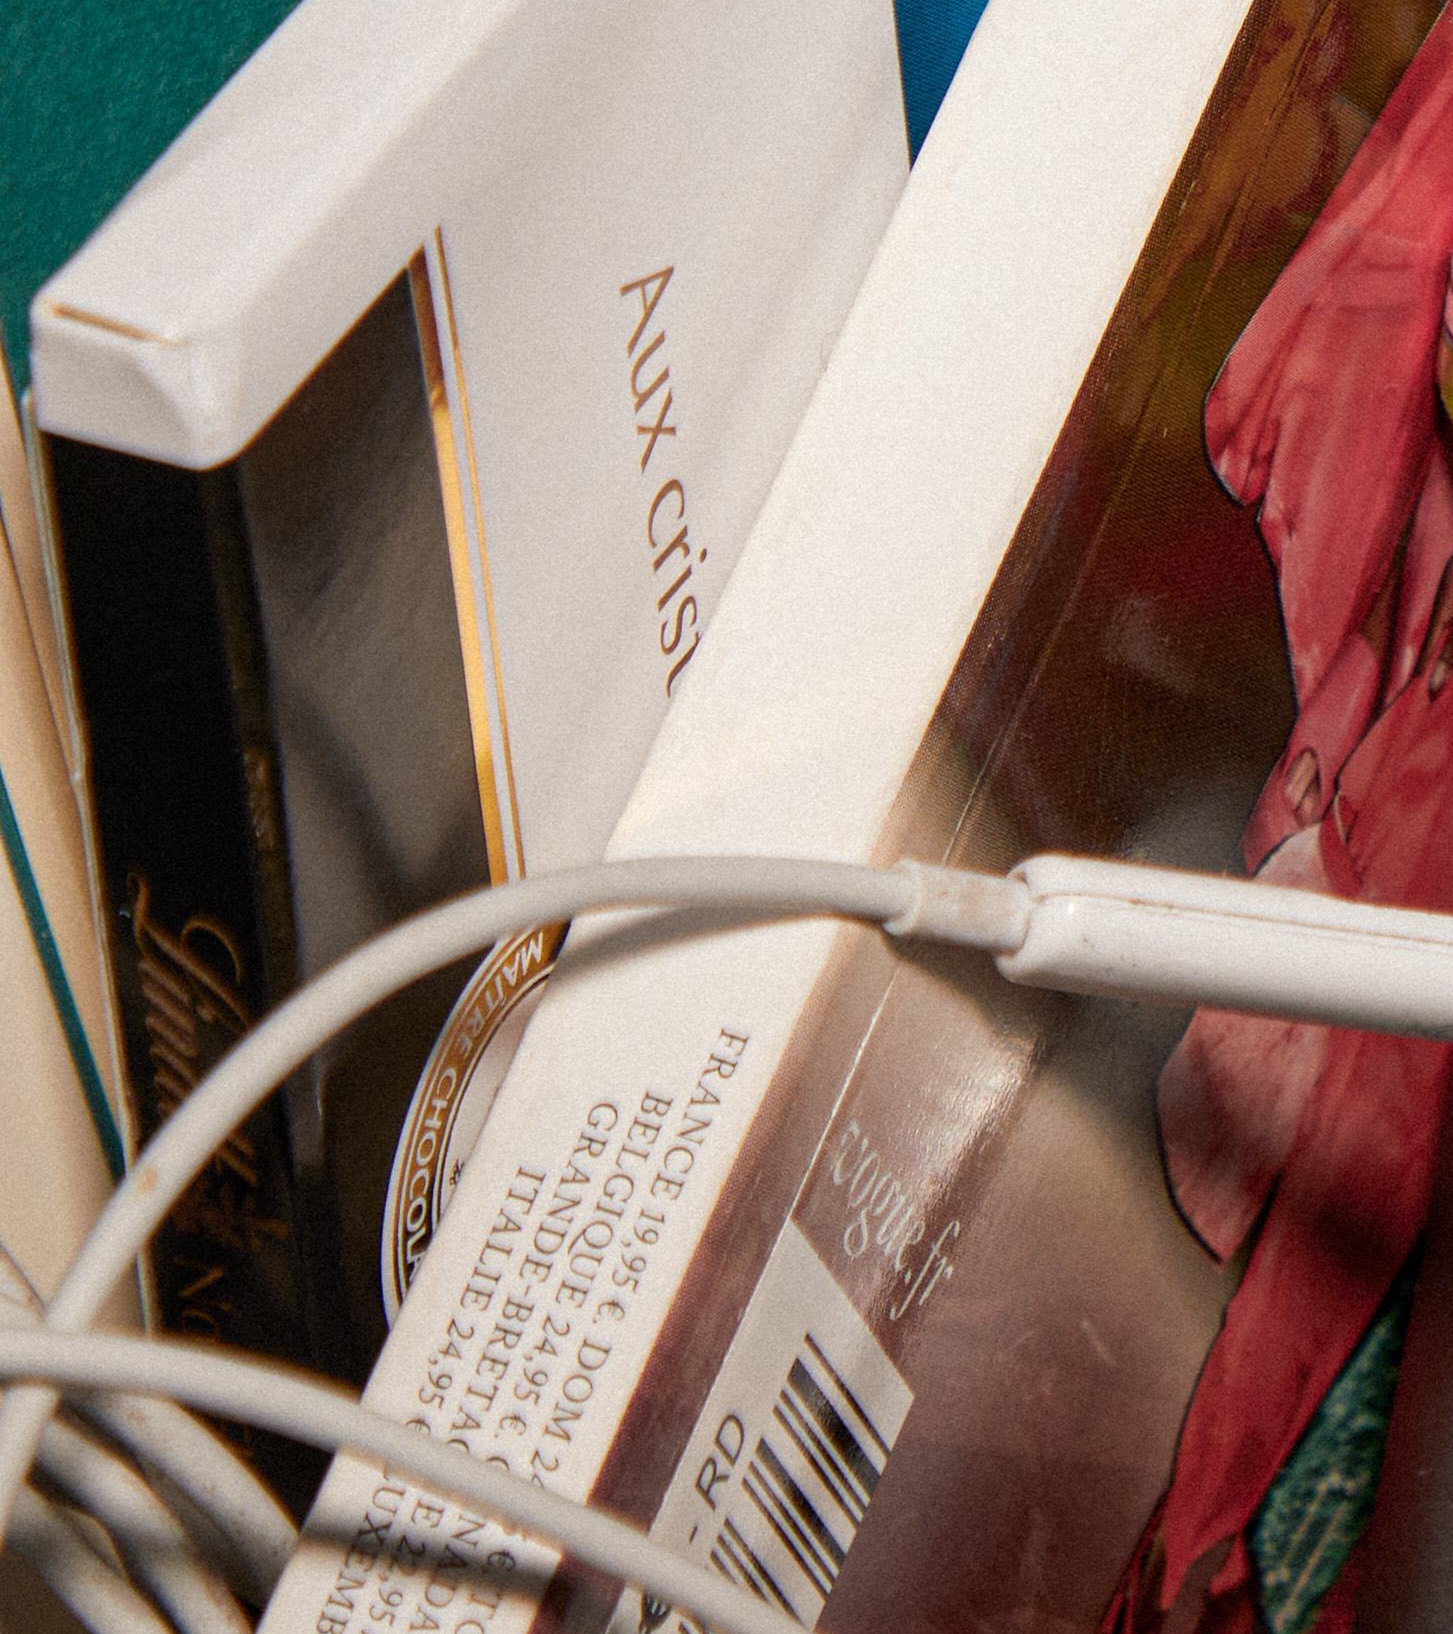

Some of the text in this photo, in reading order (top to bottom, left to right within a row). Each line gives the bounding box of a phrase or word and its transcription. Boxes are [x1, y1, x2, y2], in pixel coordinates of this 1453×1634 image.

[619, 264, 682, 467] Aux
[648, 1026, 751, 1202] FRANCE
[458, 1166, 547, 1312] ITALIE
[553, 1088, 676, 1312] BELGIQUE
[610, 1207, 668, 1296] 19,95
[830, 1122, 964, 1323] vogue.fr
[416, 1316, 476, 1411] 24,95
[512, 1312, 572, 1406] 24,95
[543, 1336, 614, 1450] DOM
[694, 1412, 747, 1512] RD
